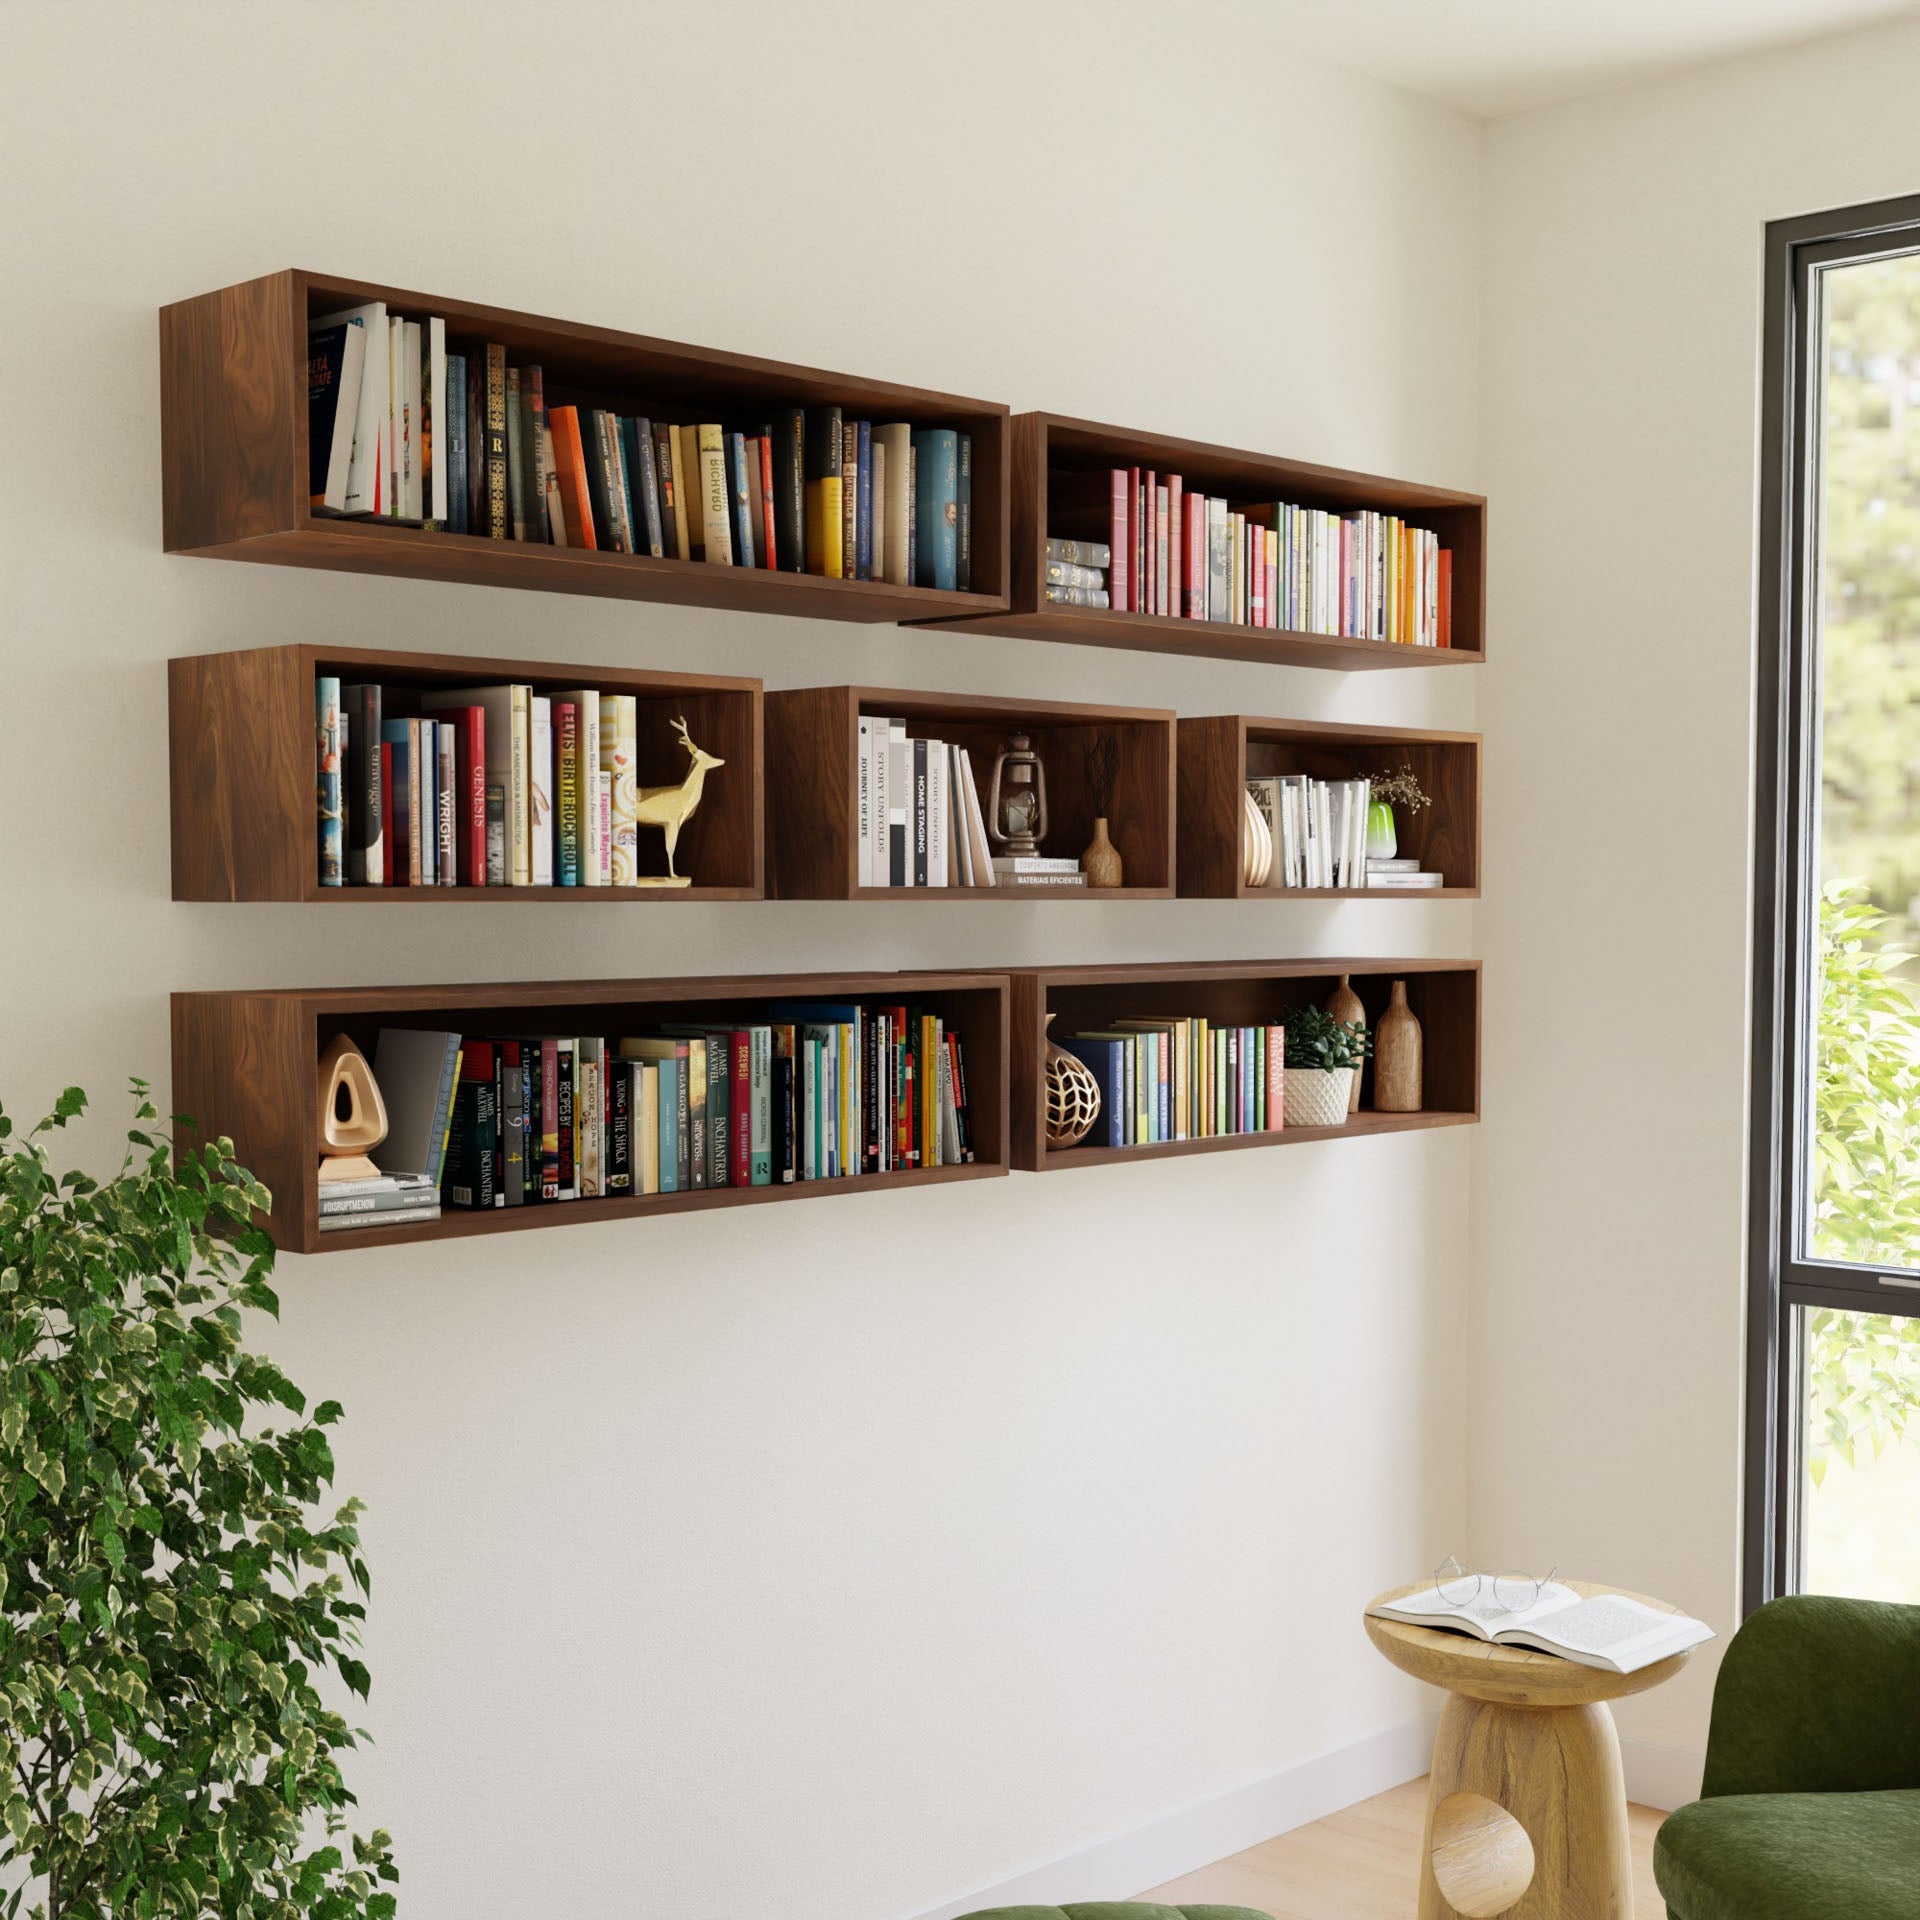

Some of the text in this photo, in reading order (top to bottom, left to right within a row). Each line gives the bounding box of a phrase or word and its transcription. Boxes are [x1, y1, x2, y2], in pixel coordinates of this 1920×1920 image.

[493, 437, 504, 453] R
[513, 737, 521, 751] THE
[589, 723, 597, 752] William
[368, 744, 381, 817] Caravaggio
[513, 753, 521, 792] AMERICAS
[562, 711, 577, 876] ELVIS BIRTH ROCK ROLL
[473, 765, 485, 829] GENESIS
[861, 803, 868, 816] OF
[877, 752, 885, 854] STORY UNFOLDS
[917, 775, 925, 854] HOME STAGING
[439, 790, 451, 856] WRIGHT
[513, 800, 521, 845] ANTARCTICA
[601, 792, 610, 870] Exquisite Mayhem
[1017, 876, 1083, 885] MATERIAIS EFICIENTES
[709, 1040, 719, 1085] MAXWELL
[719, 1049, 728, 1077] JAMES
[738, 1045, 749, 1080] SCREWED!
[1270, 1033, 1278, 1094] HISTORY
[477, 1087, 488, 1124] MAXWELL
[487, 1092, 495, 1117] JAMES
[522, 1083, 530, 1113] TANGO
[558, 1081, 572, 1114] RECIPES
[587, 1067, 596, 1111] BEACON
[678, 1074, 687, 1130] GARGOYLE
[558, 1116, 571, 1126] BY
[558, 1128, 571, 1149] REAL
[614, 1079, 627, 1165] YOUNG THE SHACK
[693, 1119, 701, 1161] NEWTON
[714, 1116, 727, 1183] ENCHANTRESS
[481, 1150, 493, 1206] ENCHANTRESS
